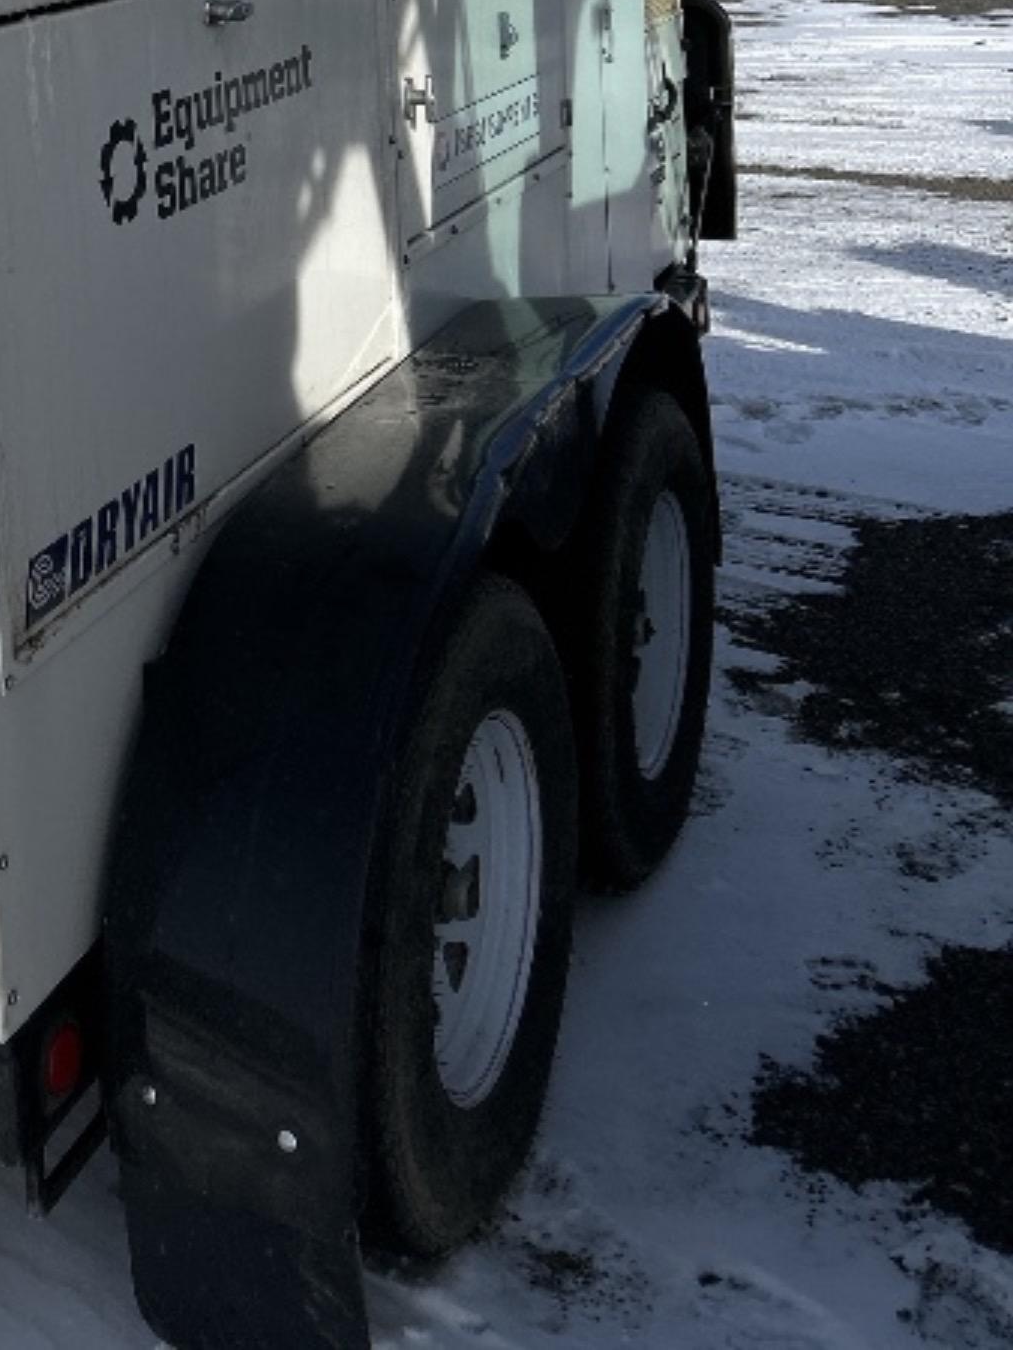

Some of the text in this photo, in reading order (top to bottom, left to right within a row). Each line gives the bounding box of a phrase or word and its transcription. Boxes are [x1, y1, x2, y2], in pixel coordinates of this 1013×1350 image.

[151, 45, 313, 150] Equipment
[154, 140, 247, 220] Share
[68, 442, 195, 598] DRYAIR
